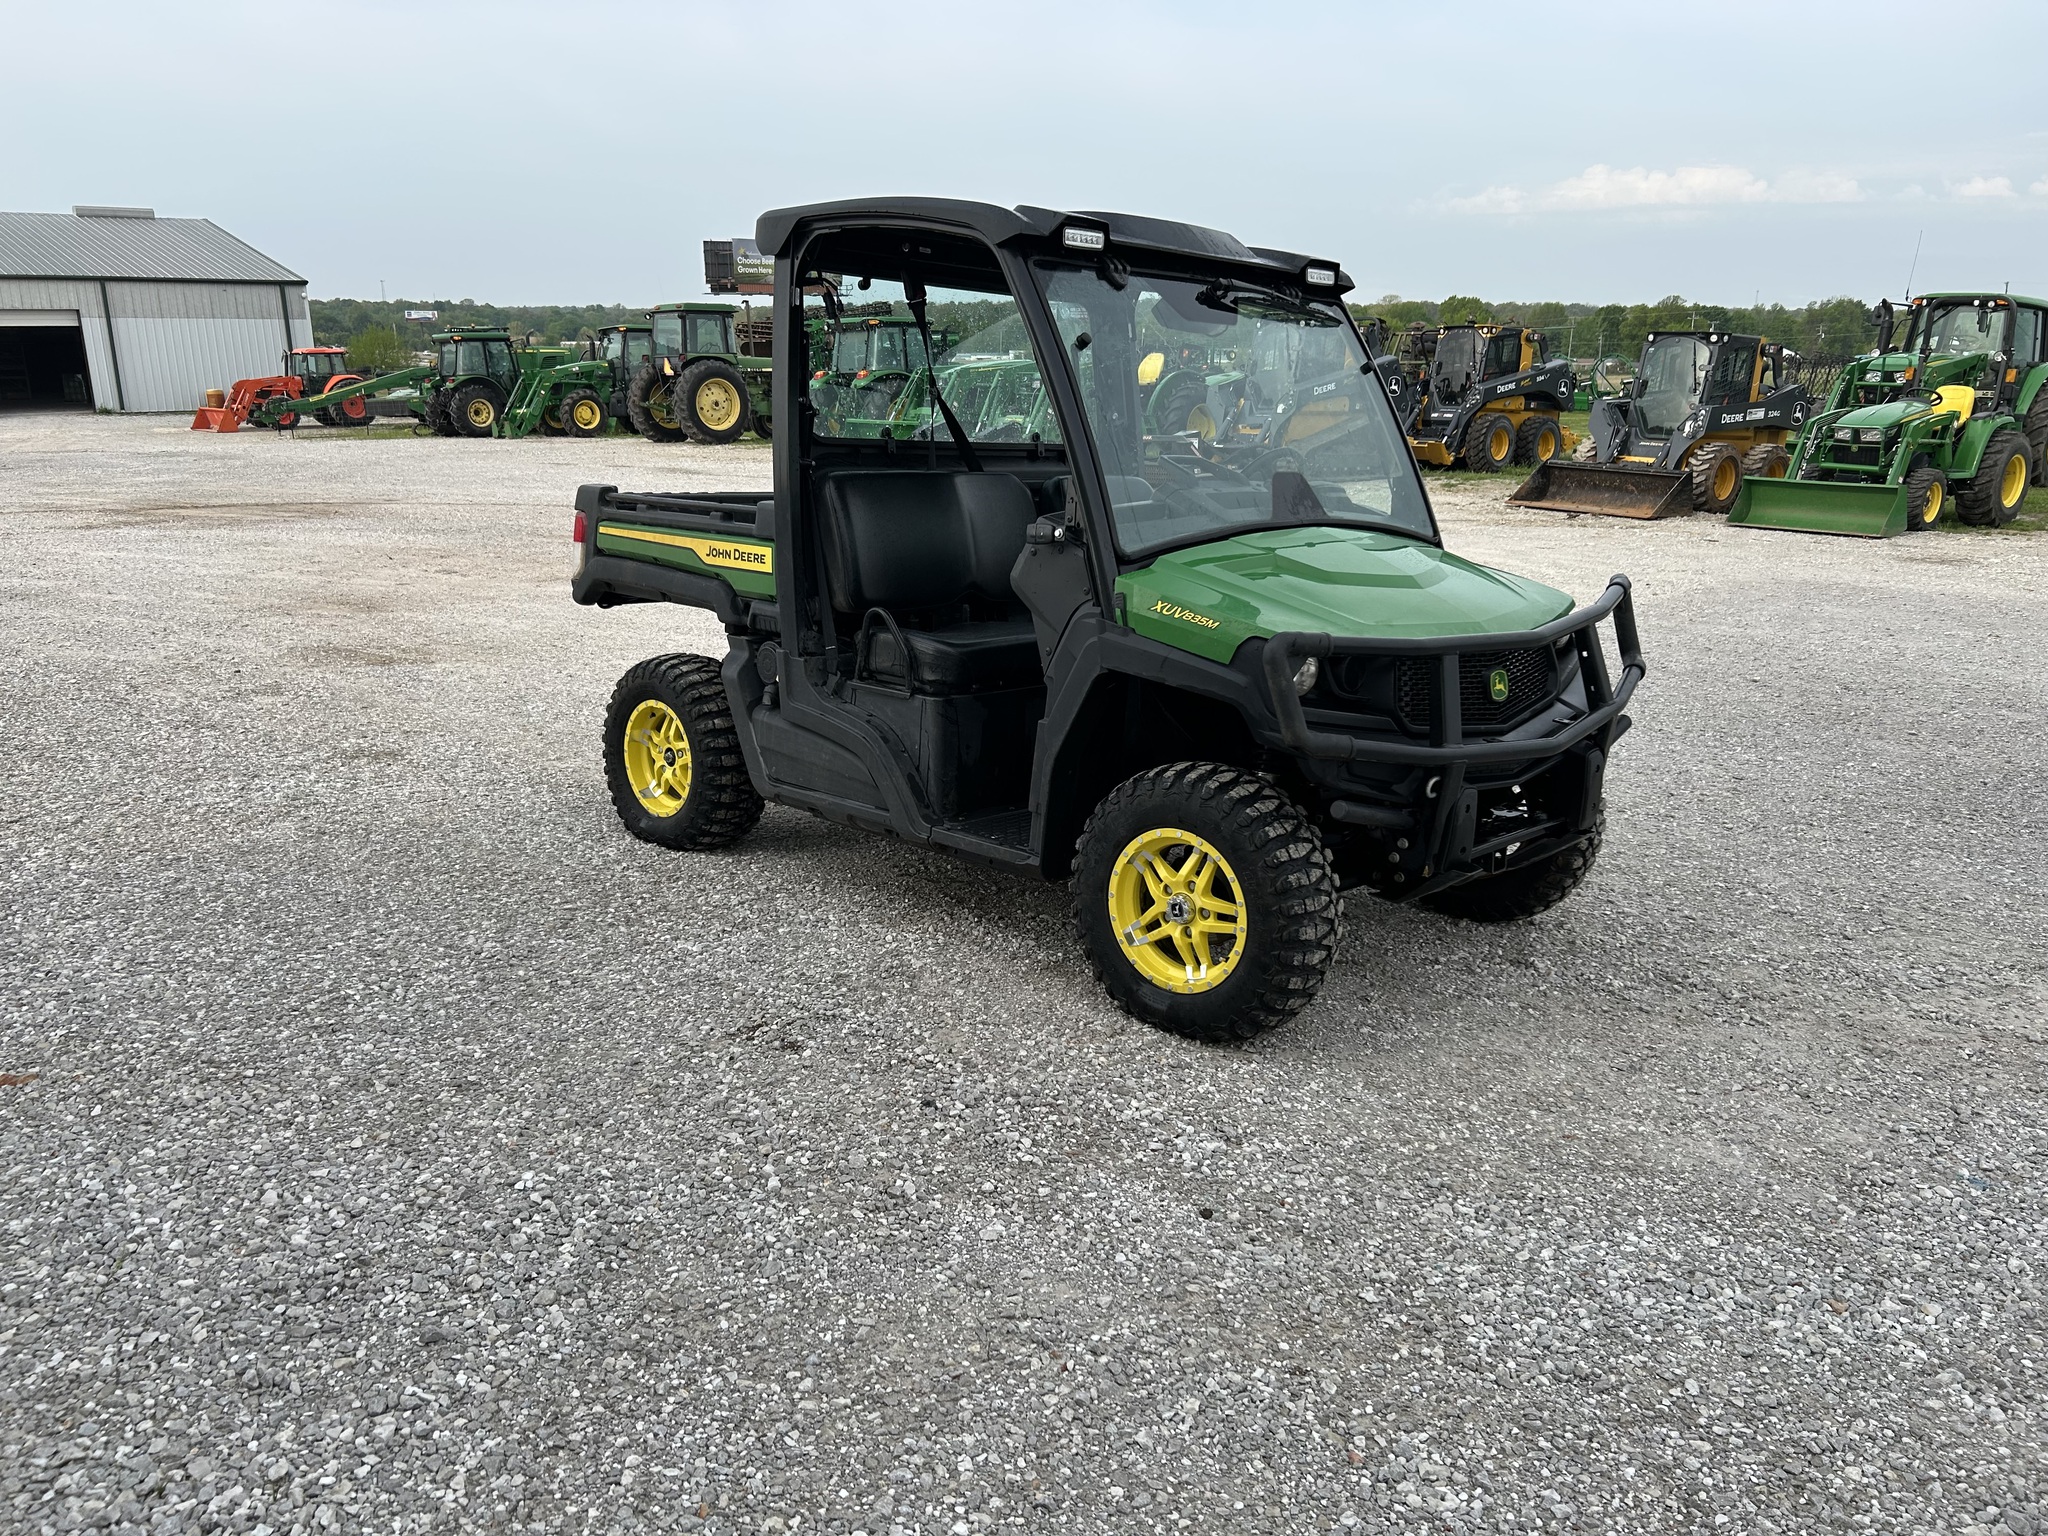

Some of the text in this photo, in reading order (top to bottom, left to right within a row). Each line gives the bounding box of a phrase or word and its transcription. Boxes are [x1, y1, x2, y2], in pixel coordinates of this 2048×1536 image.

[737, 256, 761, 265] Choose
[737, 265, 773, 274] Grown Here
[1313, 382, 1337, 395] DEERE
[1496, 382, 1516, 394] DEERE
[1720, 413, 1744, 424] DEERE
[705, 545, 766, 565] JOHN DEERE
[1150, 600, 1221, 630] XUV835M
